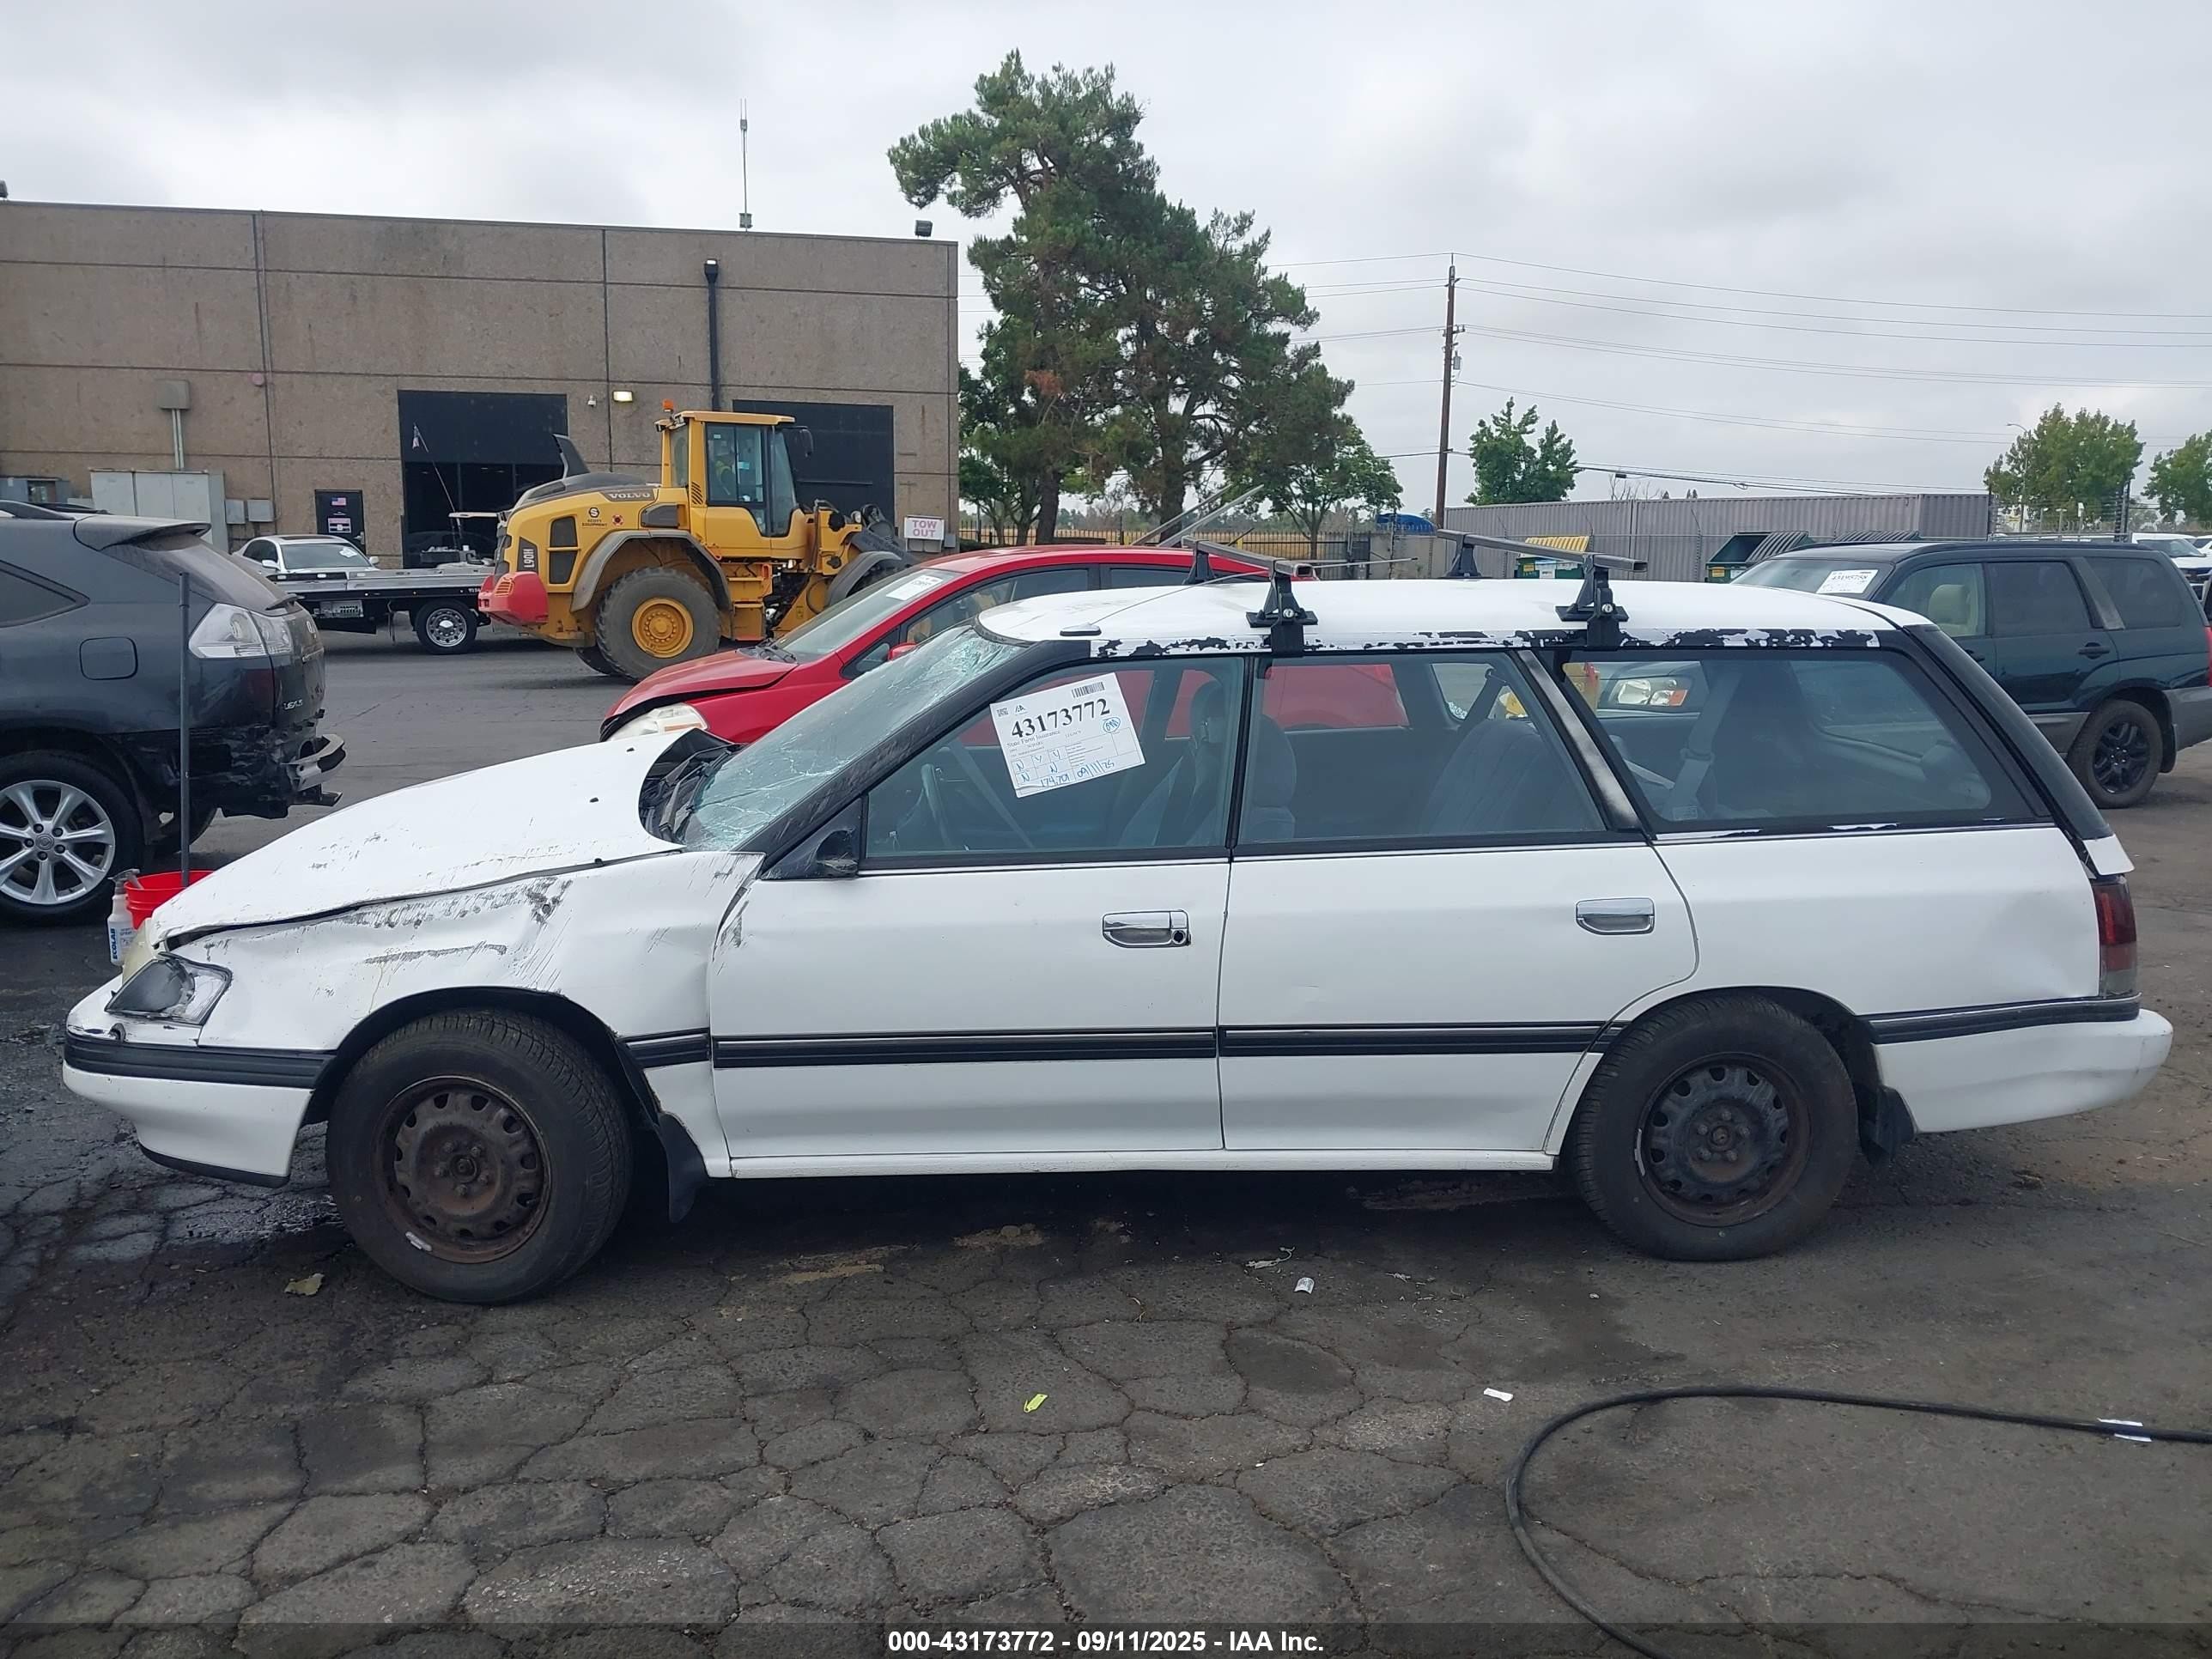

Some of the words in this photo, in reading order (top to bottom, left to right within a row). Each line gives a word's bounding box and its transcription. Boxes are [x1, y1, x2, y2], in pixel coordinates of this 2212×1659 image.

[912, 520, 937, 529] TOW
[913, 529, 936, 538] OUT
[523, 548, 535, 568] L90H
[1012, 698, 1110, 738] 43173772
[1020, 736, 1036, 744] Farm
[110, 927, 118, 960] ECOLAB
